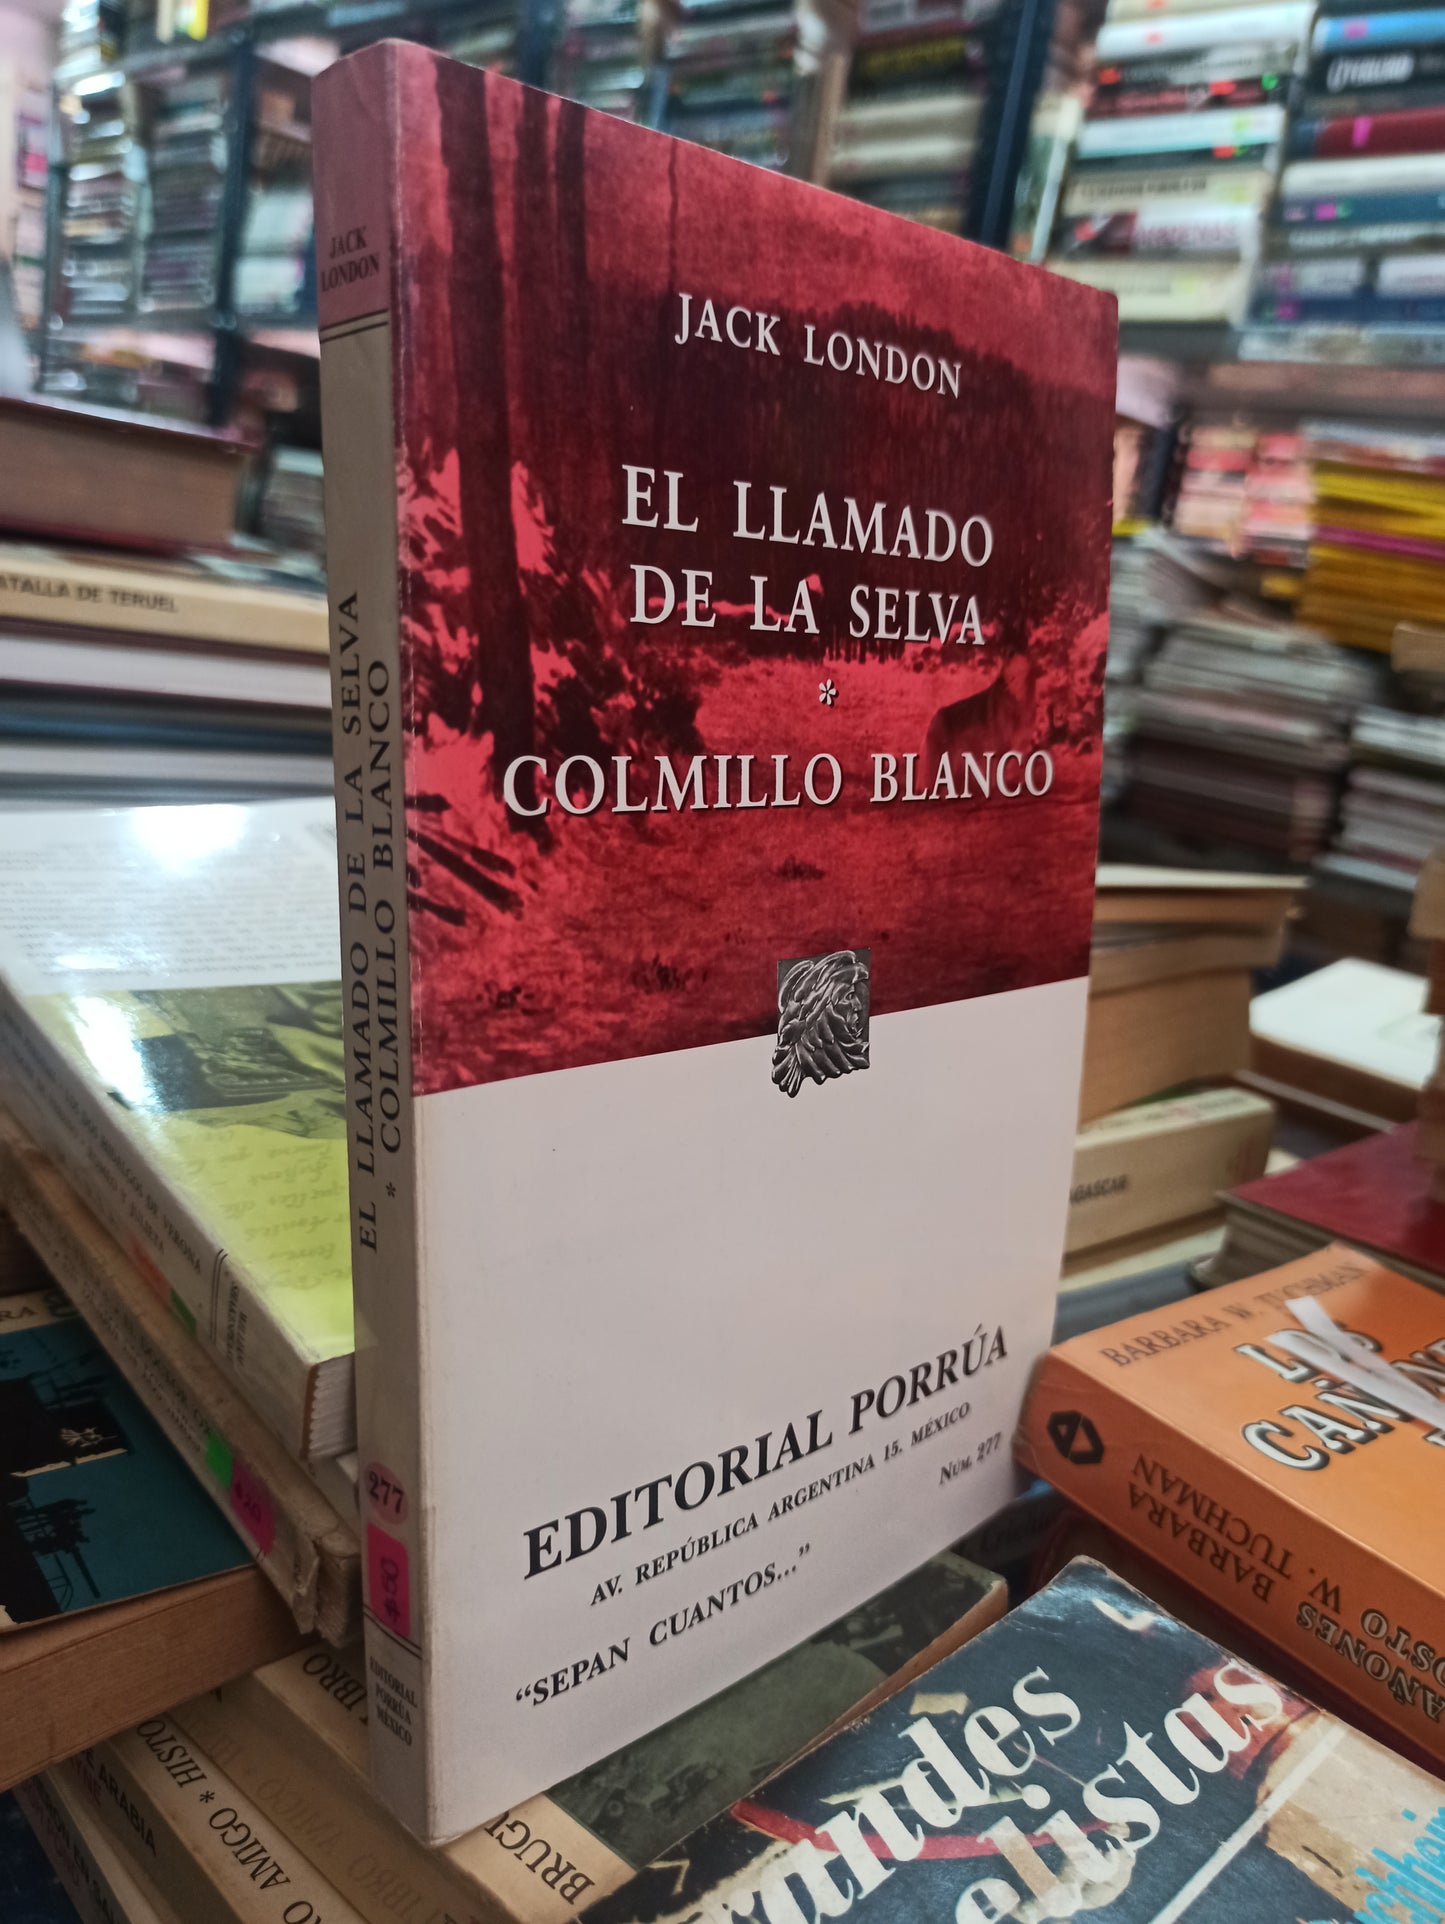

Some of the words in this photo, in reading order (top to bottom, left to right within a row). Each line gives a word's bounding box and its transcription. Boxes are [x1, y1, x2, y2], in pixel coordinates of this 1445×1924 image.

[321, 252, 380, 292] LONDON
[329, 225, 368, 259] JACK
[674, 292, 781, 356] JACK
[803, 324, 962, 399] LONDON
[621, 463, 699, 533] EL
[733, 480, 993, 567] LLAMADO
[76, 584, 105, 605] DE
[109, 588, 179, 613] TERUEL
[629, 563, 717, 628] DE
[749, 574, 820, 635] LA
[848, 583, 986, 646] SELVA
[338, 592, 362, 736] SELVA
[344, 765, 364, 826] LA
[368, 660, 394, 872] BLANCO
[503, 751, 843, 816] COLMILLO
[869, 749, 1054, 803] BLANCO
[347, 853, 368, 914] DE
[350, 941, 375, 1178] LLAMADO
[373, 899, 401, 1154] COLMILLO
[358, 1201, 378, 1253] EL
[1099, 1314, 1231, 1368] BARBARA
[523, 1409, 833, 1580] EDITORIAL
[848, 1323, 1008, 1435] PORRÚA
[976, 1432, 1003, 1463] 277
[368, 1469, 406, 1515] 277
[590, 1579, 624, 1606] AV.
[634, 1512, 760, 1585] REPÚBLICA
[767, 1453, 876, 1521] ARGENTINA
[882, 1438, 903, 1462] 15.
[911, 1402, 972, 1447] MÉXICO
[1130, 1453, 1295, 1580] TUCHMAN
[1128, 1480, 1276, 1604] BARBARA
[1306, 1567, 1343, 1615] W.
[303, 1652, 369, 1726] IBRO
[369, 1655, 418, 1709] EDITORIAL
[136, 1719, 207, 1788] HISTO
[376, 1703, 413, 1748] MÉXICO
[100, 1763, 157, 1858] ARABIA
[208, 1807, 291, 1890] AMIGO
